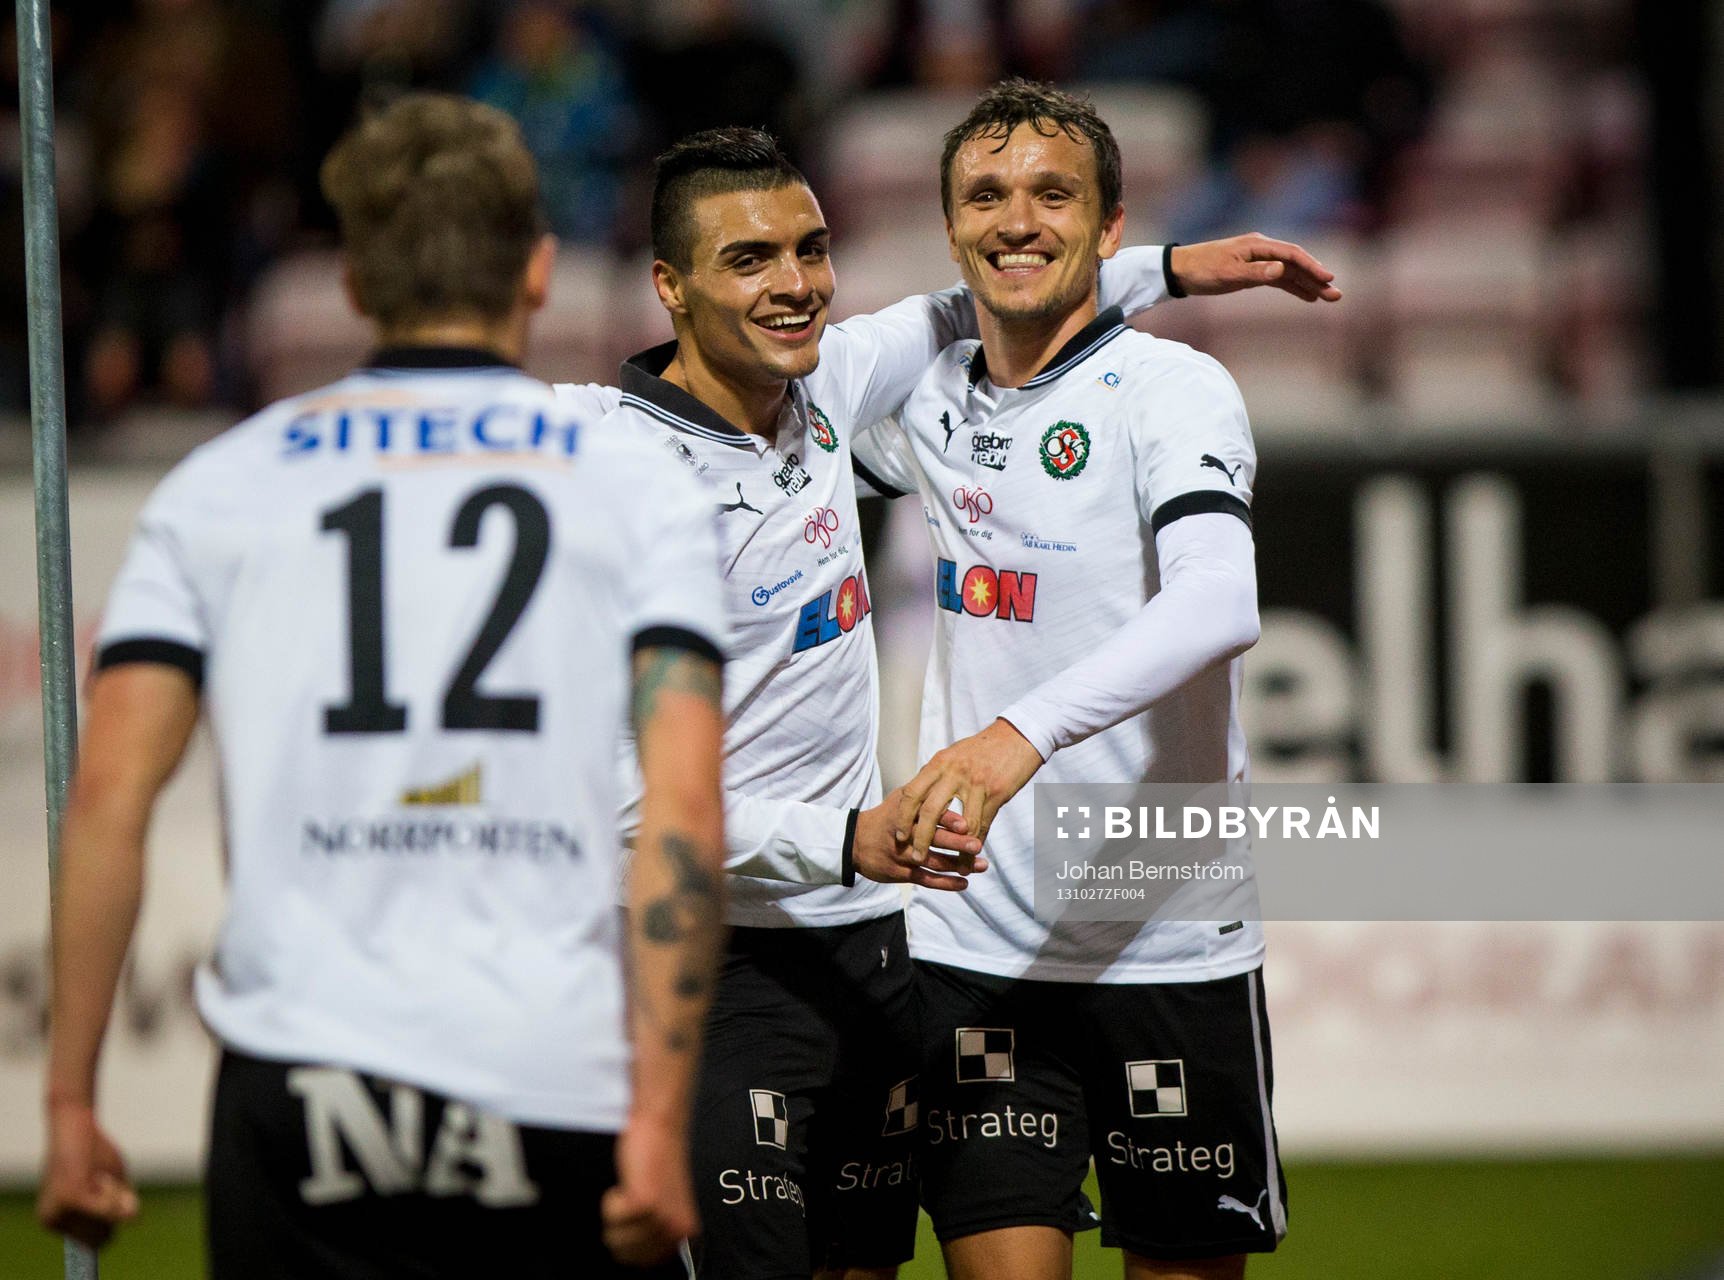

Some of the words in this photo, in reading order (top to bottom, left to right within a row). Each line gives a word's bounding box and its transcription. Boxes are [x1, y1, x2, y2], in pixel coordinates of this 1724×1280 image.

[284, 405, 579, 456] SITECH
[319, 482, 552, 733] 12
[937, 557, 1038, 623] ELON
[927, 1105, 1058, 1148] Strateg
[1107, 1131, 1235, 1179] Strateg
